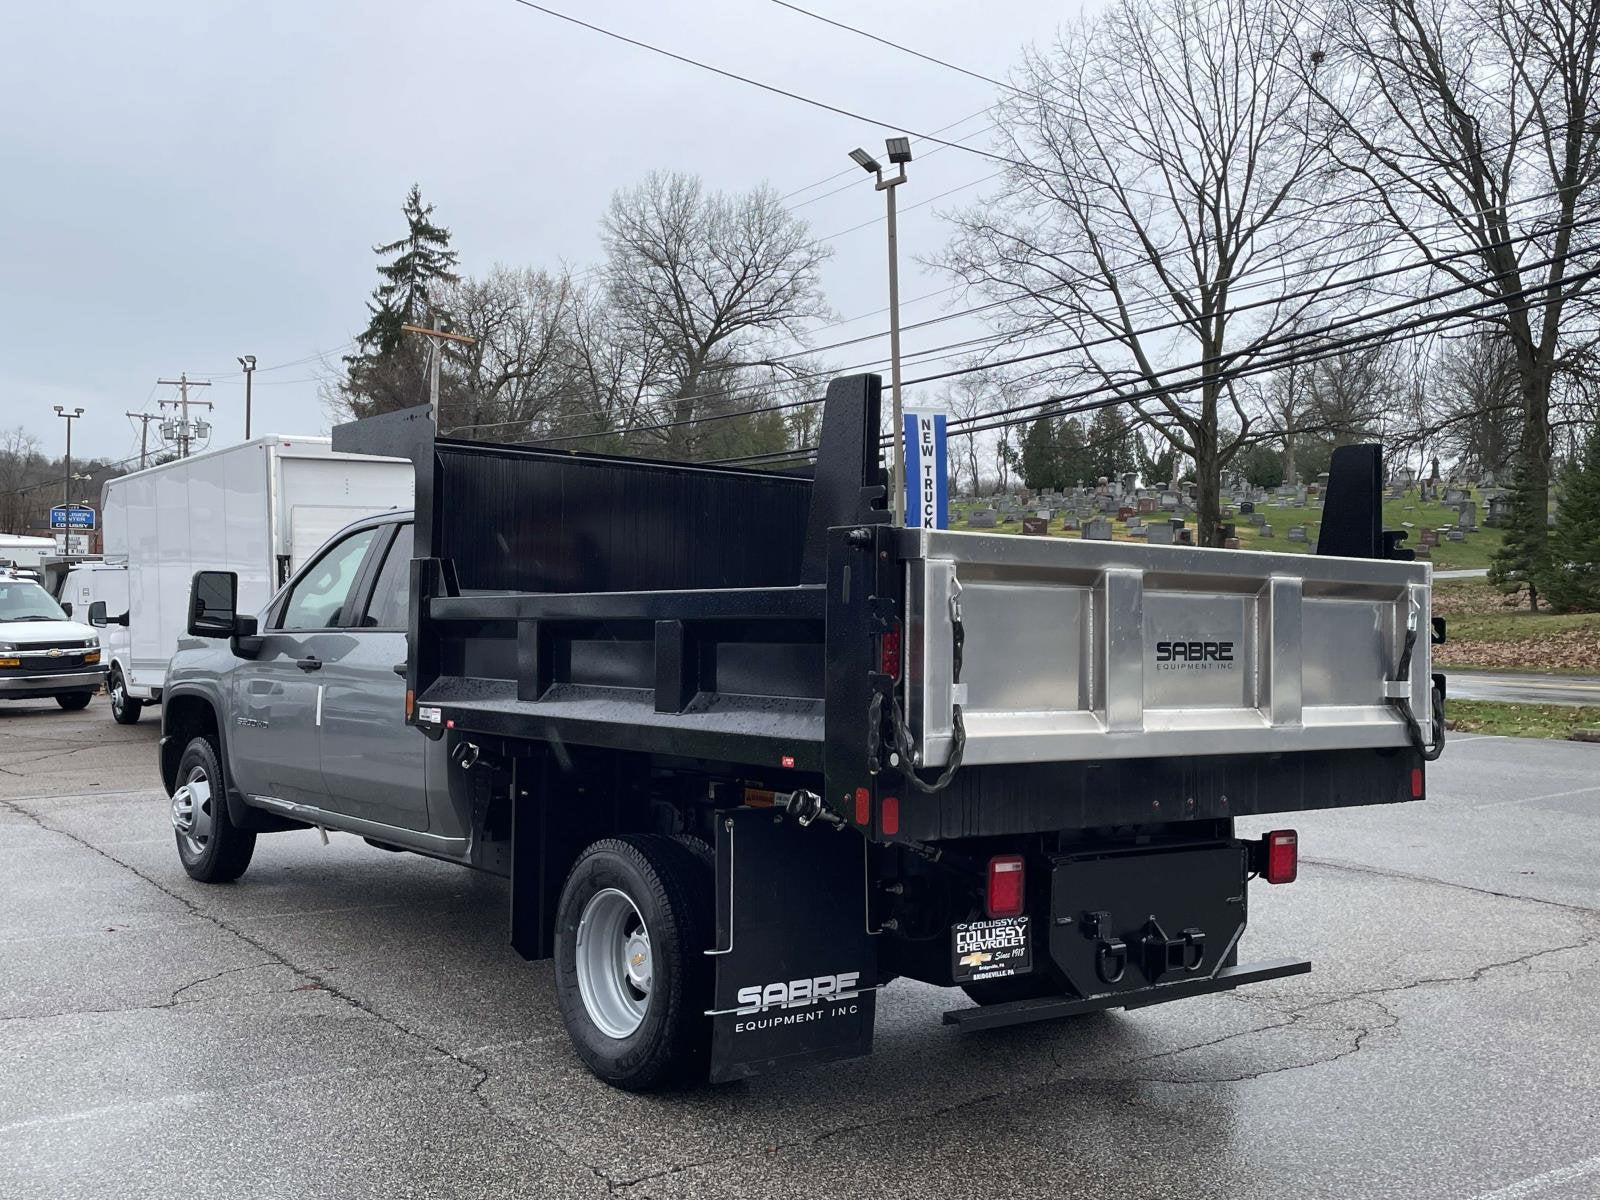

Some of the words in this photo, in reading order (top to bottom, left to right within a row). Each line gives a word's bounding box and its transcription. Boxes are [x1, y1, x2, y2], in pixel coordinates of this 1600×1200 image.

[921, 419, 933, 457] NEW
[924, 465, 933, 529] TRUCK
[1156, 641, 1234, 662] SABRE
[1156, 663, 1212, 671] EQUIPMENT
[972, 918, 1014, 930] COLUSSY
[956, 925, 1027, 945] COLUSSY
[956, 936, 1026, 954] CHEVROLET
[994, 951, 1011, 961] Since
[1011, 947, 1026, 958] 1918
[736, 971, 860, 1016] SABRE
[735, 1010, 824, 1033] EQUIPMENT
[831, 1005, 858, 1017] INC
